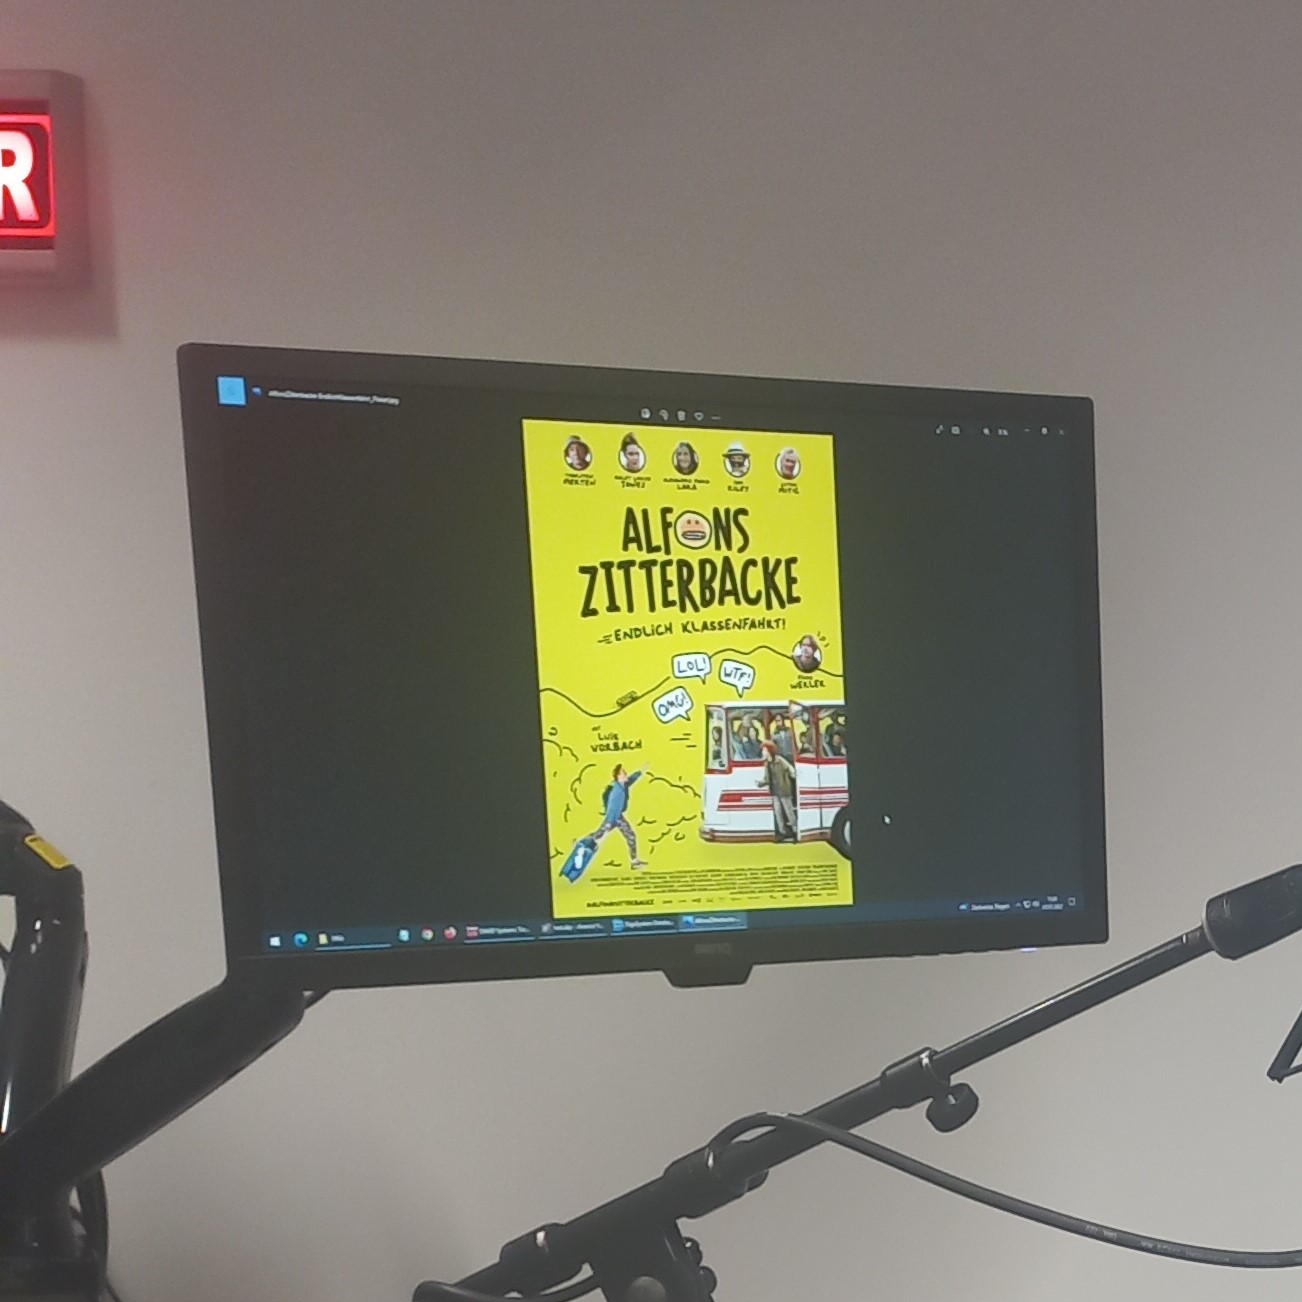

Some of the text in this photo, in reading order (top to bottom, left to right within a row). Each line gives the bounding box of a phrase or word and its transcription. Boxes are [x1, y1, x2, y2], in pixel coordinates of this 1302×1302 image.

[622, 506, 750, 556] ALFONS
[578, 556, 802, 618] ZITTERBACKE
[681, 617, 787, 634] KLASSENFAHRT!
[677, 656, 707, 674] LOL!
[723, 667, 752, 683] WTF!
